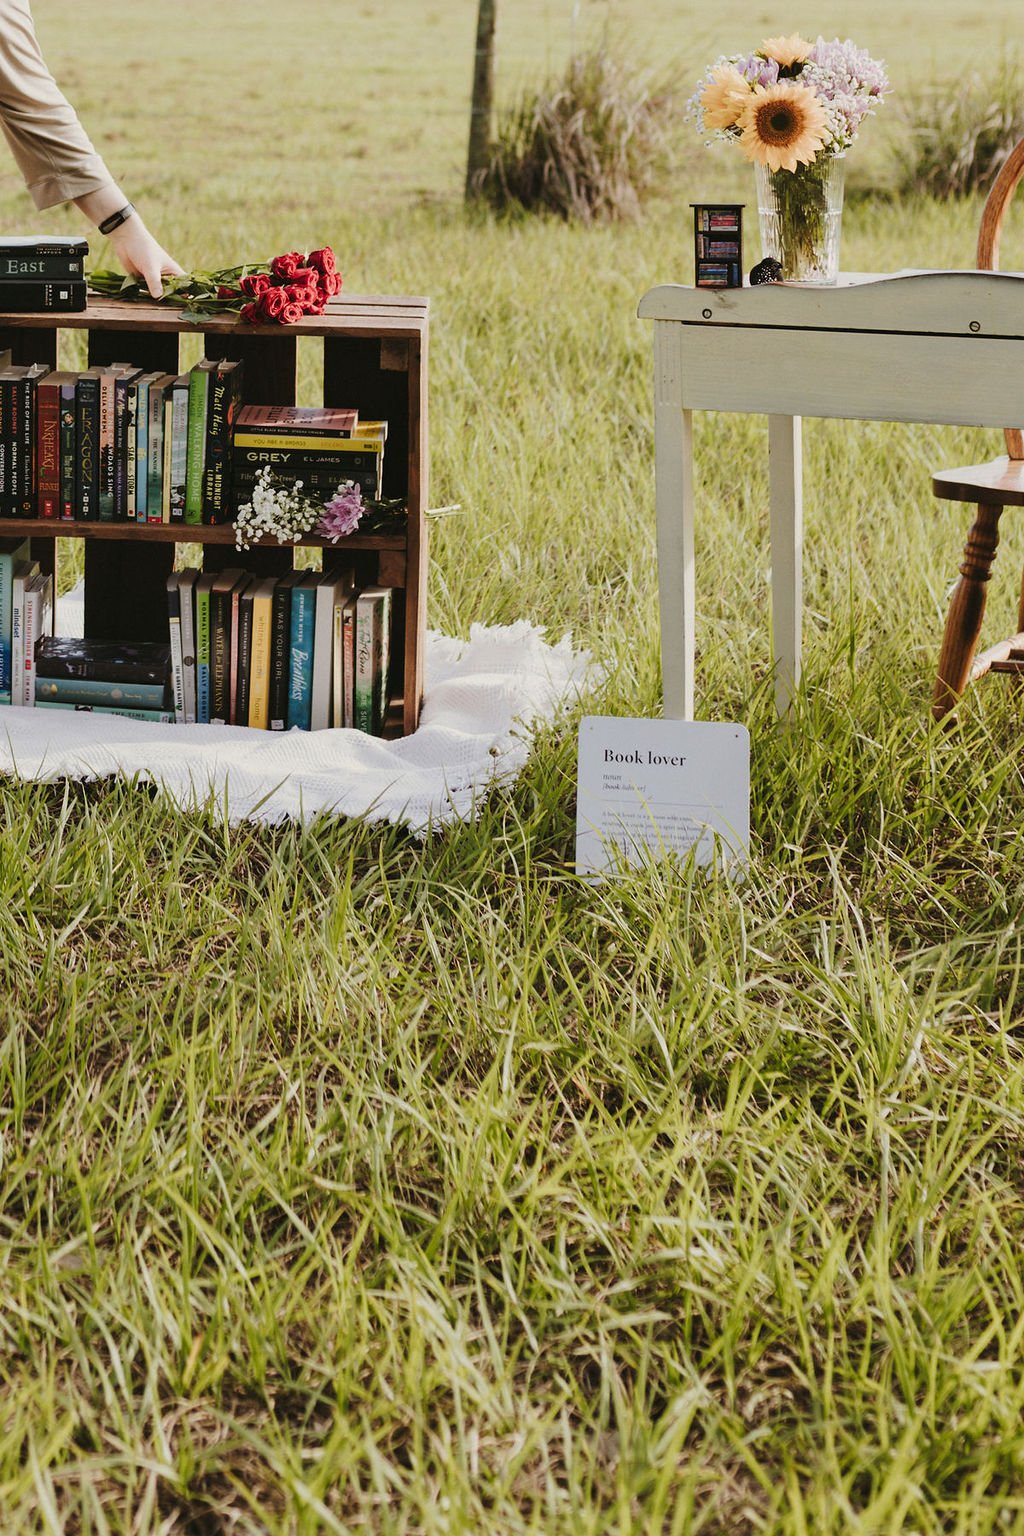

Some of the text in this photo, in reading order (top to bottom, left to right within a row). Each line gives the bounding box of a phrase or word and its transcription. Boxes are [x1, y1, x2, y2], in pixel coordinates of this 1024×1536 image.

[6, 259, 46, 274] East
[24, 410, 30, 418] OF
[209, 385, 226, 436] Matt Haig
[42, 420, 57, 471] INKHEART
[81, 407, 93, 482] ERAGON
[127, 446, 135, 461] STAR
[246, 451, 291, 463] GREY
[191, 423, 202, 503] WALKING HOME
[127, 474, 135, 495] STORM
[206, 469, 215, 501] LIBRARY
[213, 474, 223, 509] MIDNIGHT
[13, 608, 21, 638] mindset
[256, 615, 265, 647] whitney
[215, 627, 224, 655] WATER
[276, 634, 284, 656] YOUR
[275, 660, 283, 681] GIRL
[291, 648, 309, 701] Breathless
[215, 664, 224, 712] ELEPHANTS
[254, 697, 263, 721] home
[360, 710, 368, 733] SILVE
[604, 748, 687, 766] Book lover
